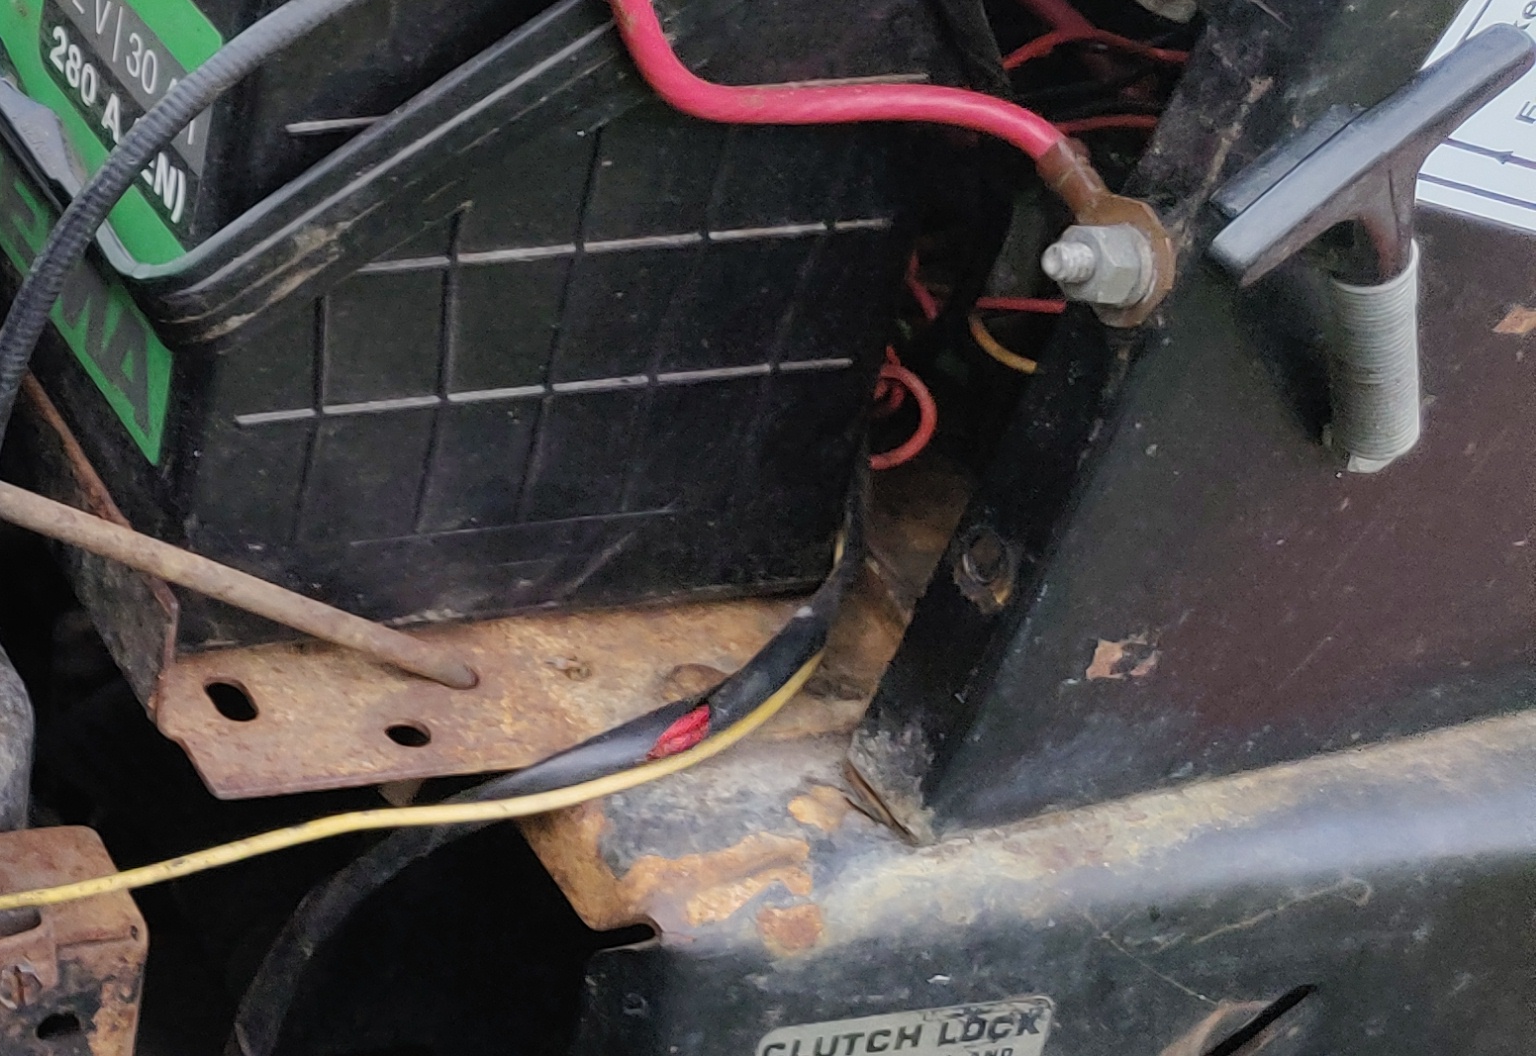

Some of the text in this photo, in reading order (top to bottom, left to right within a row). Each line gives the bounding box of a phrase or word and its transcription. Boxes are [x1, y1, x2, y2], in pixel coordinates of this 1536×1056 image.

[49, 26, 96, 107] 280
[101, 93, 120, 144] A
[763, 1008, 1041, 1056] CLUTCH LOCK
